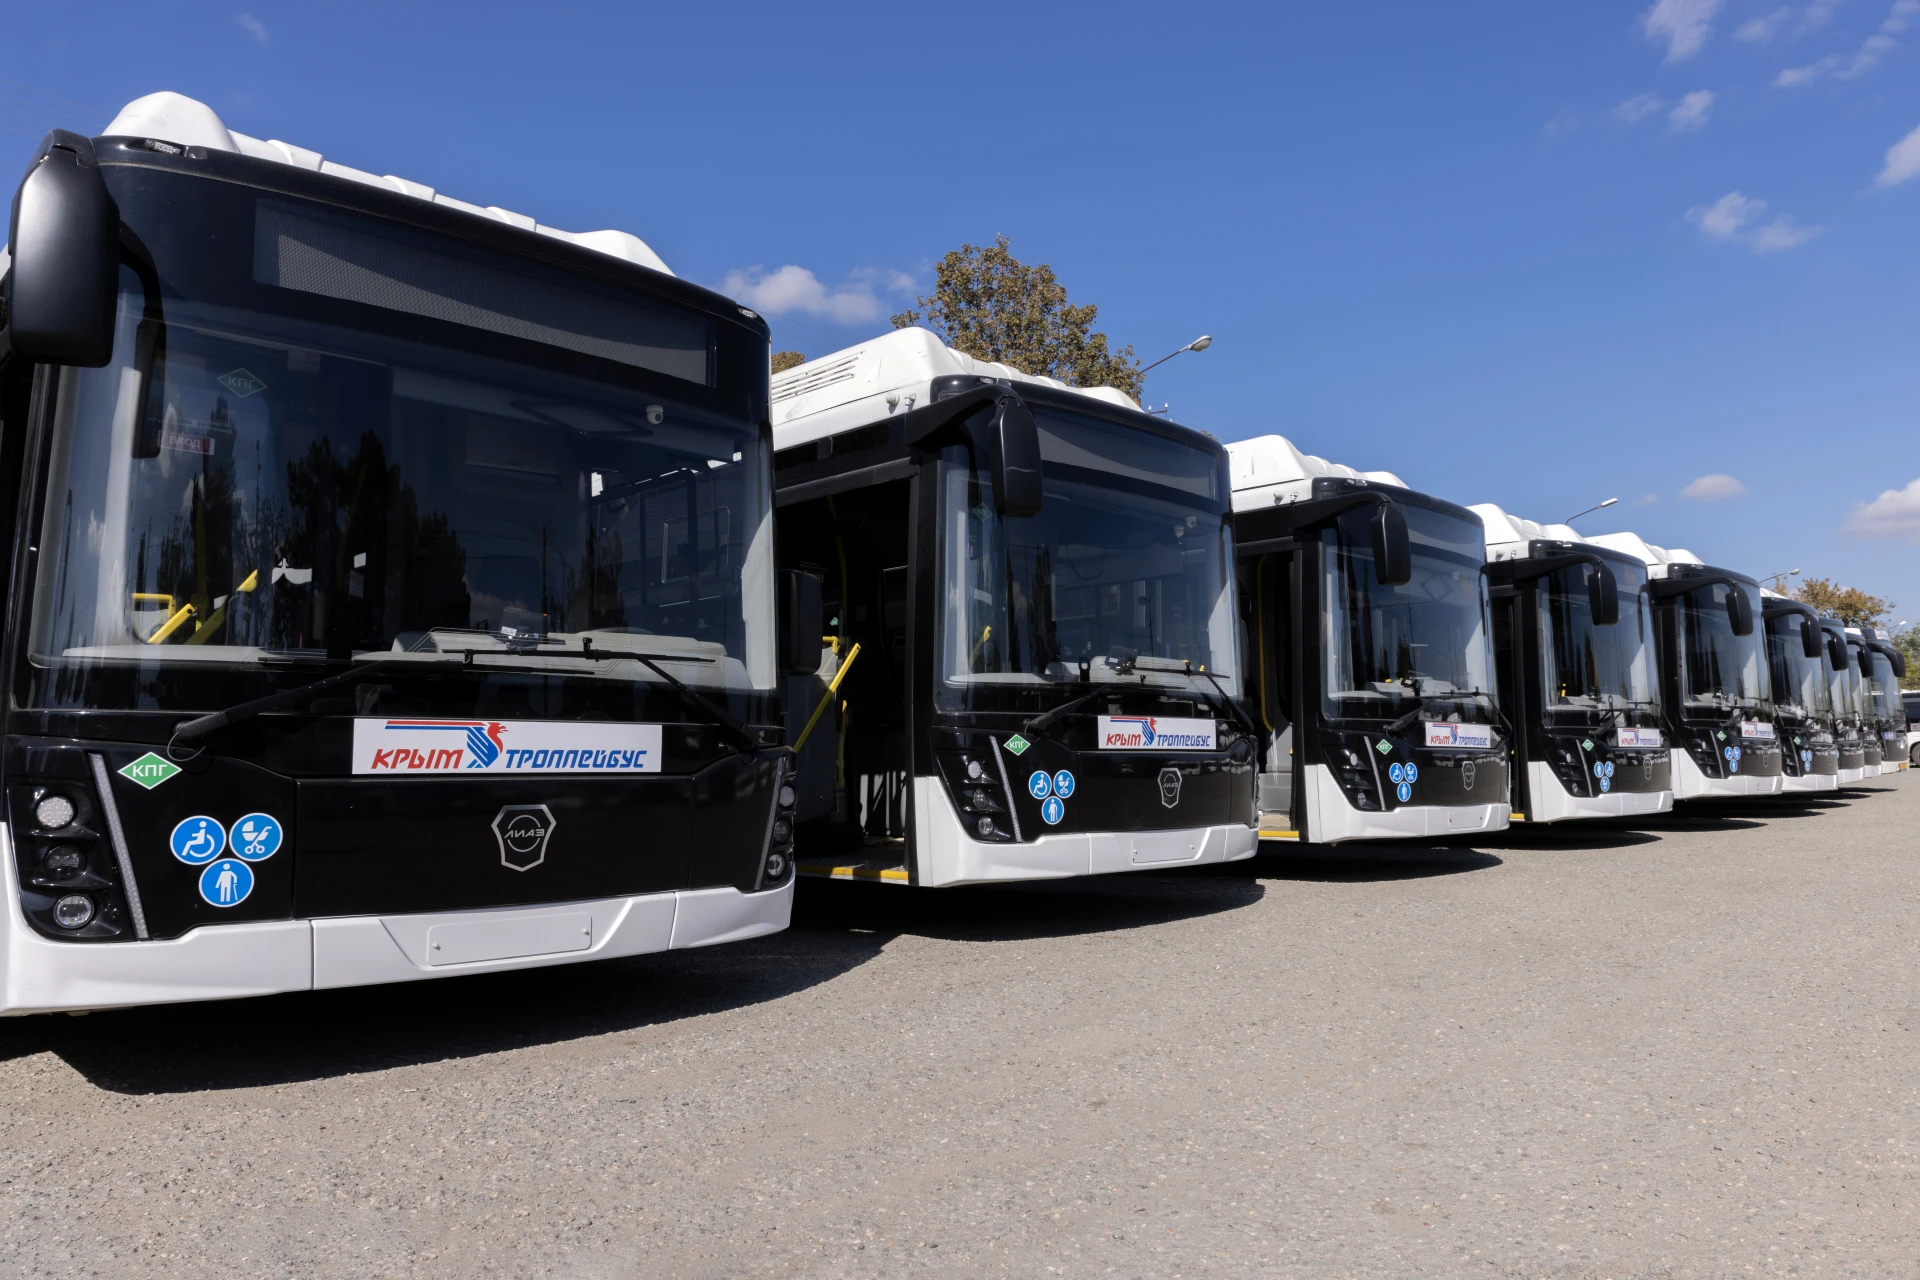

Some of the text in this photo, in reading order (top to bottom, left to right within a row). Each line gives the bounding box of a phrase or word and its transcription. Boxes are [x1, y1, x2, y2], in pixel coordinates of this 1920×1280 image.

[228, 375, 254, 389] КПГ
[169, 435, 200, 449] ВХОД
[1009, 741, 1025, 749] КПГ
[1106, 733, 1211, 747] КРЫМ ТРОЛЛЕЙБУС
[1430, 735, 1450, 745] КРЫМ
[370, 748, 648, 770] КРЫМ ТРОЛЛЕЙБУС
[132, 764, 168, 777] КПГ
[504, 828, 545, 838] ЛИАЗ
